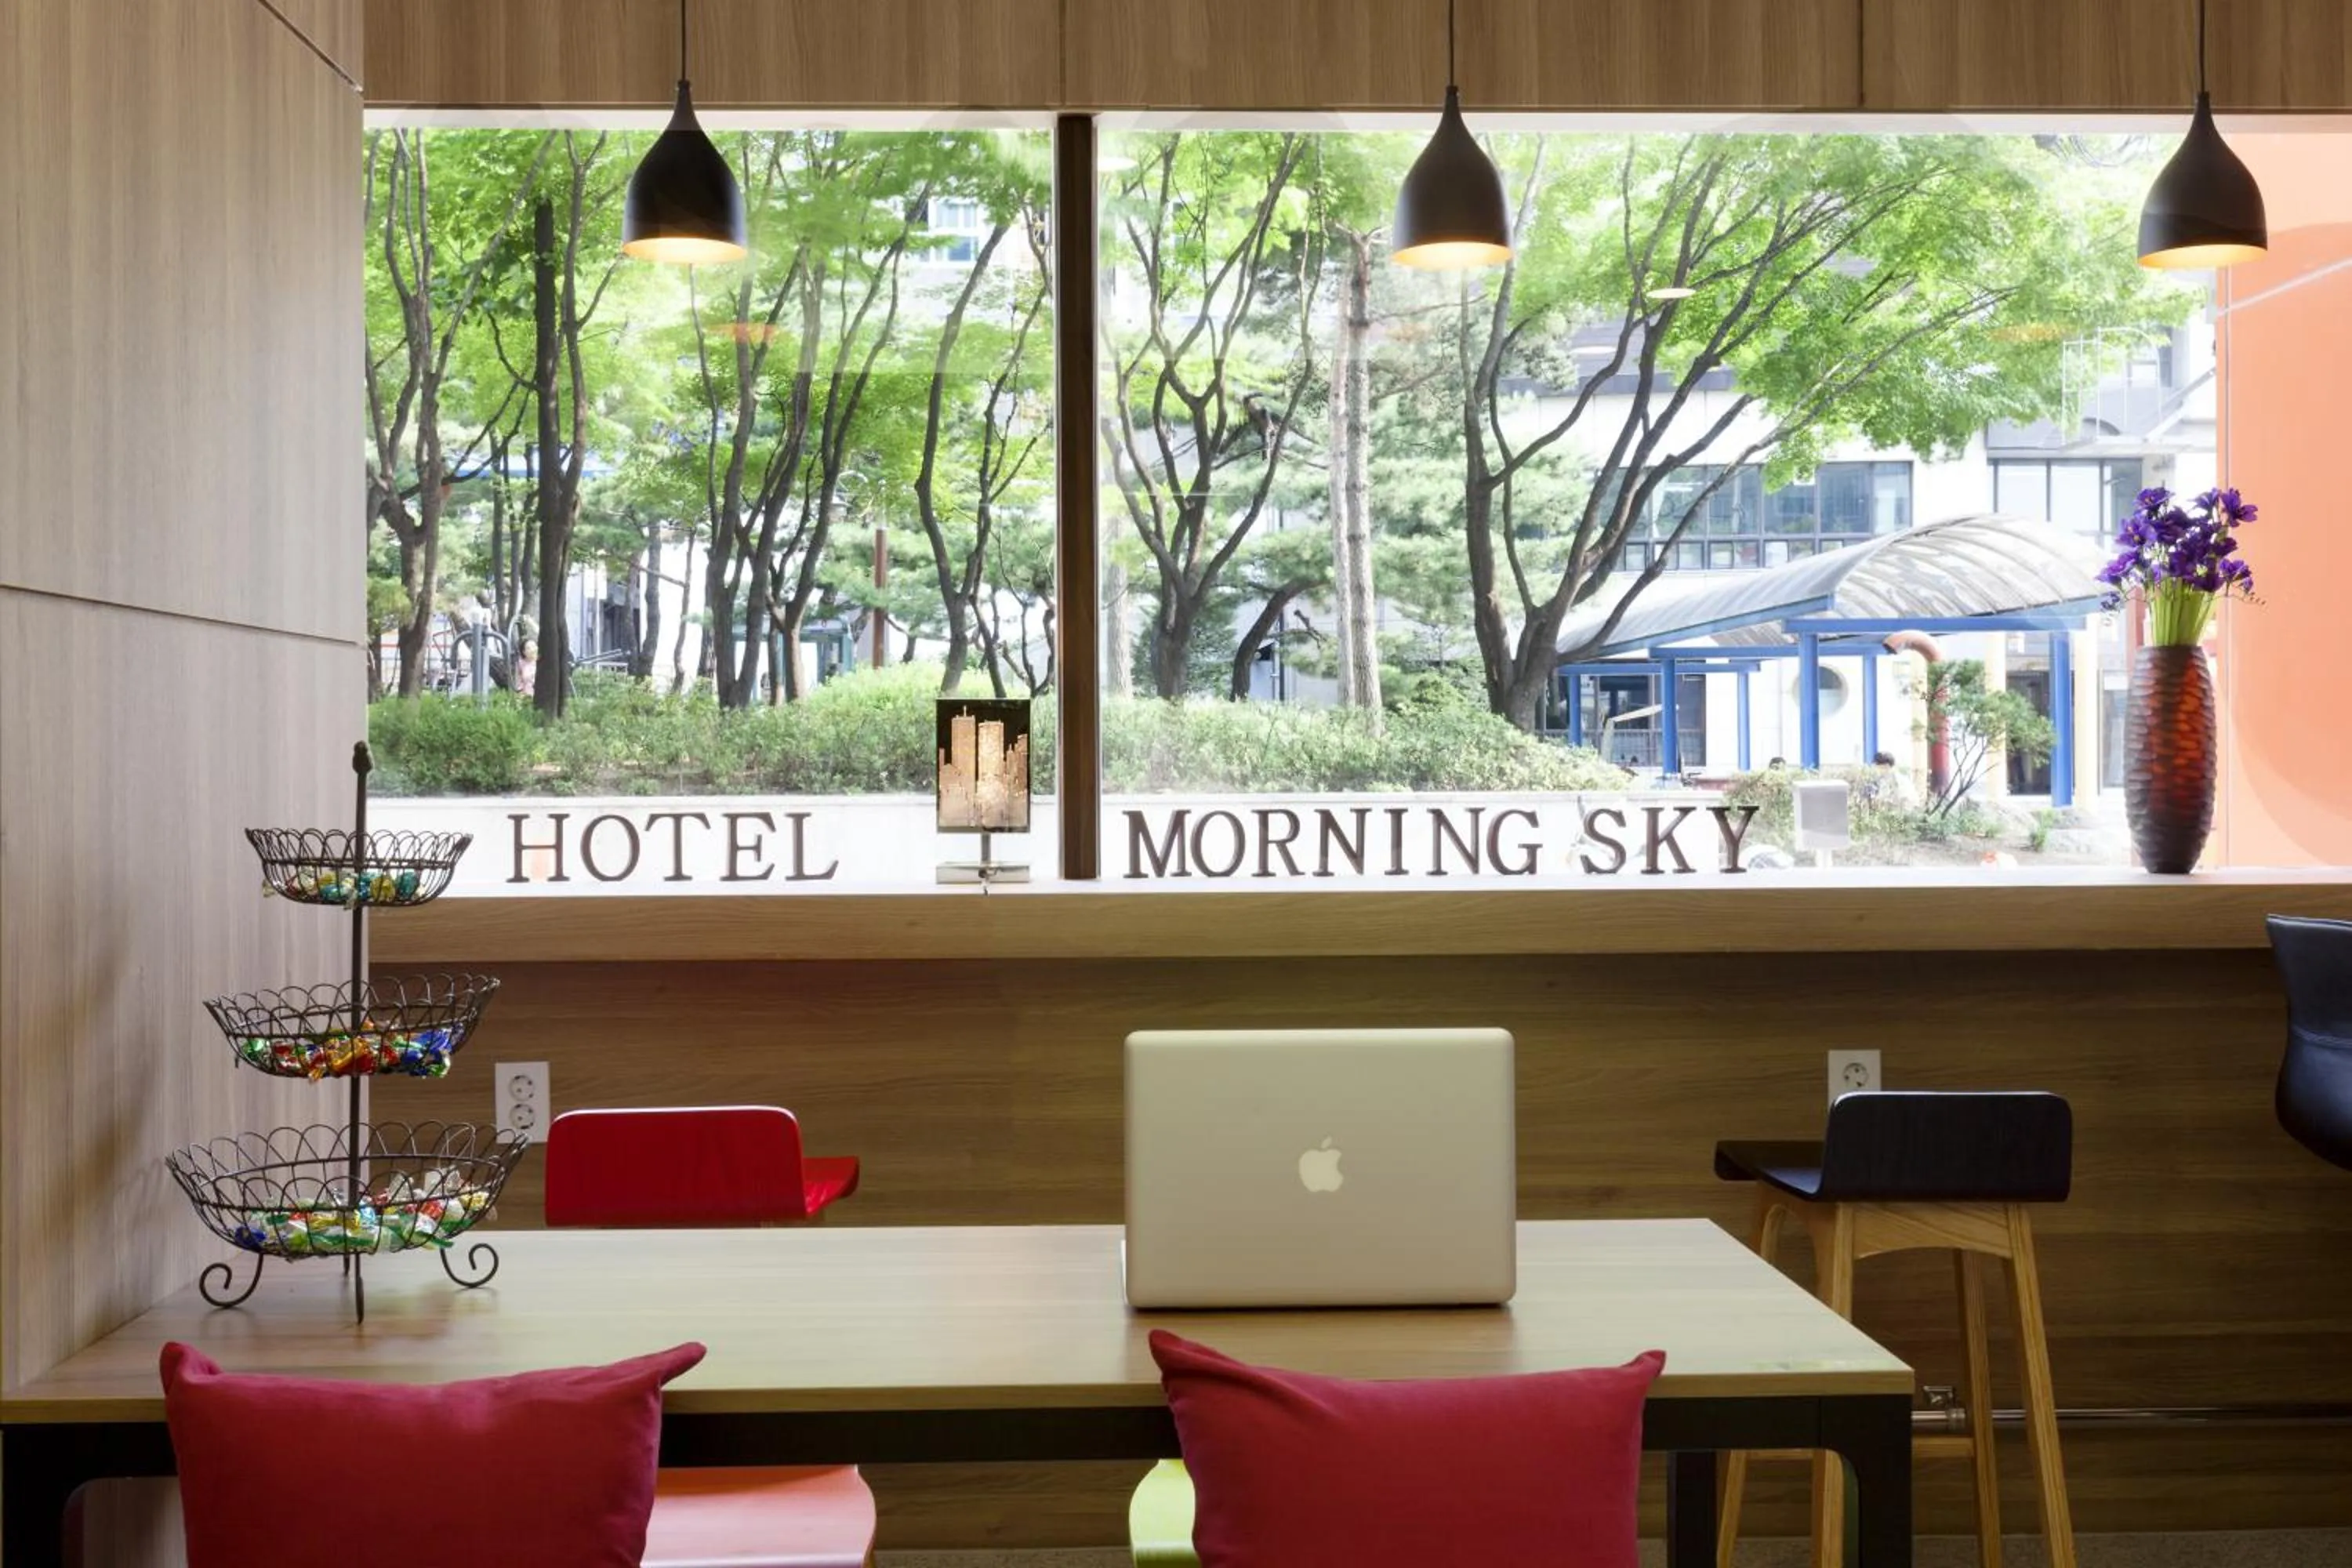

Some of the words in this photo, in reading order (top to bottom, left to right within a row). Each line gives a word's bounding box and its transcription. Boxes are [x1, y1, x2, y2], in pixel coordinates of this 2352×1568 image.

[506, 812, 839, 883] HOTEL
[1123, 807, 1543, 878] MORNING
[1580, 805, 1760, 875] SKY
